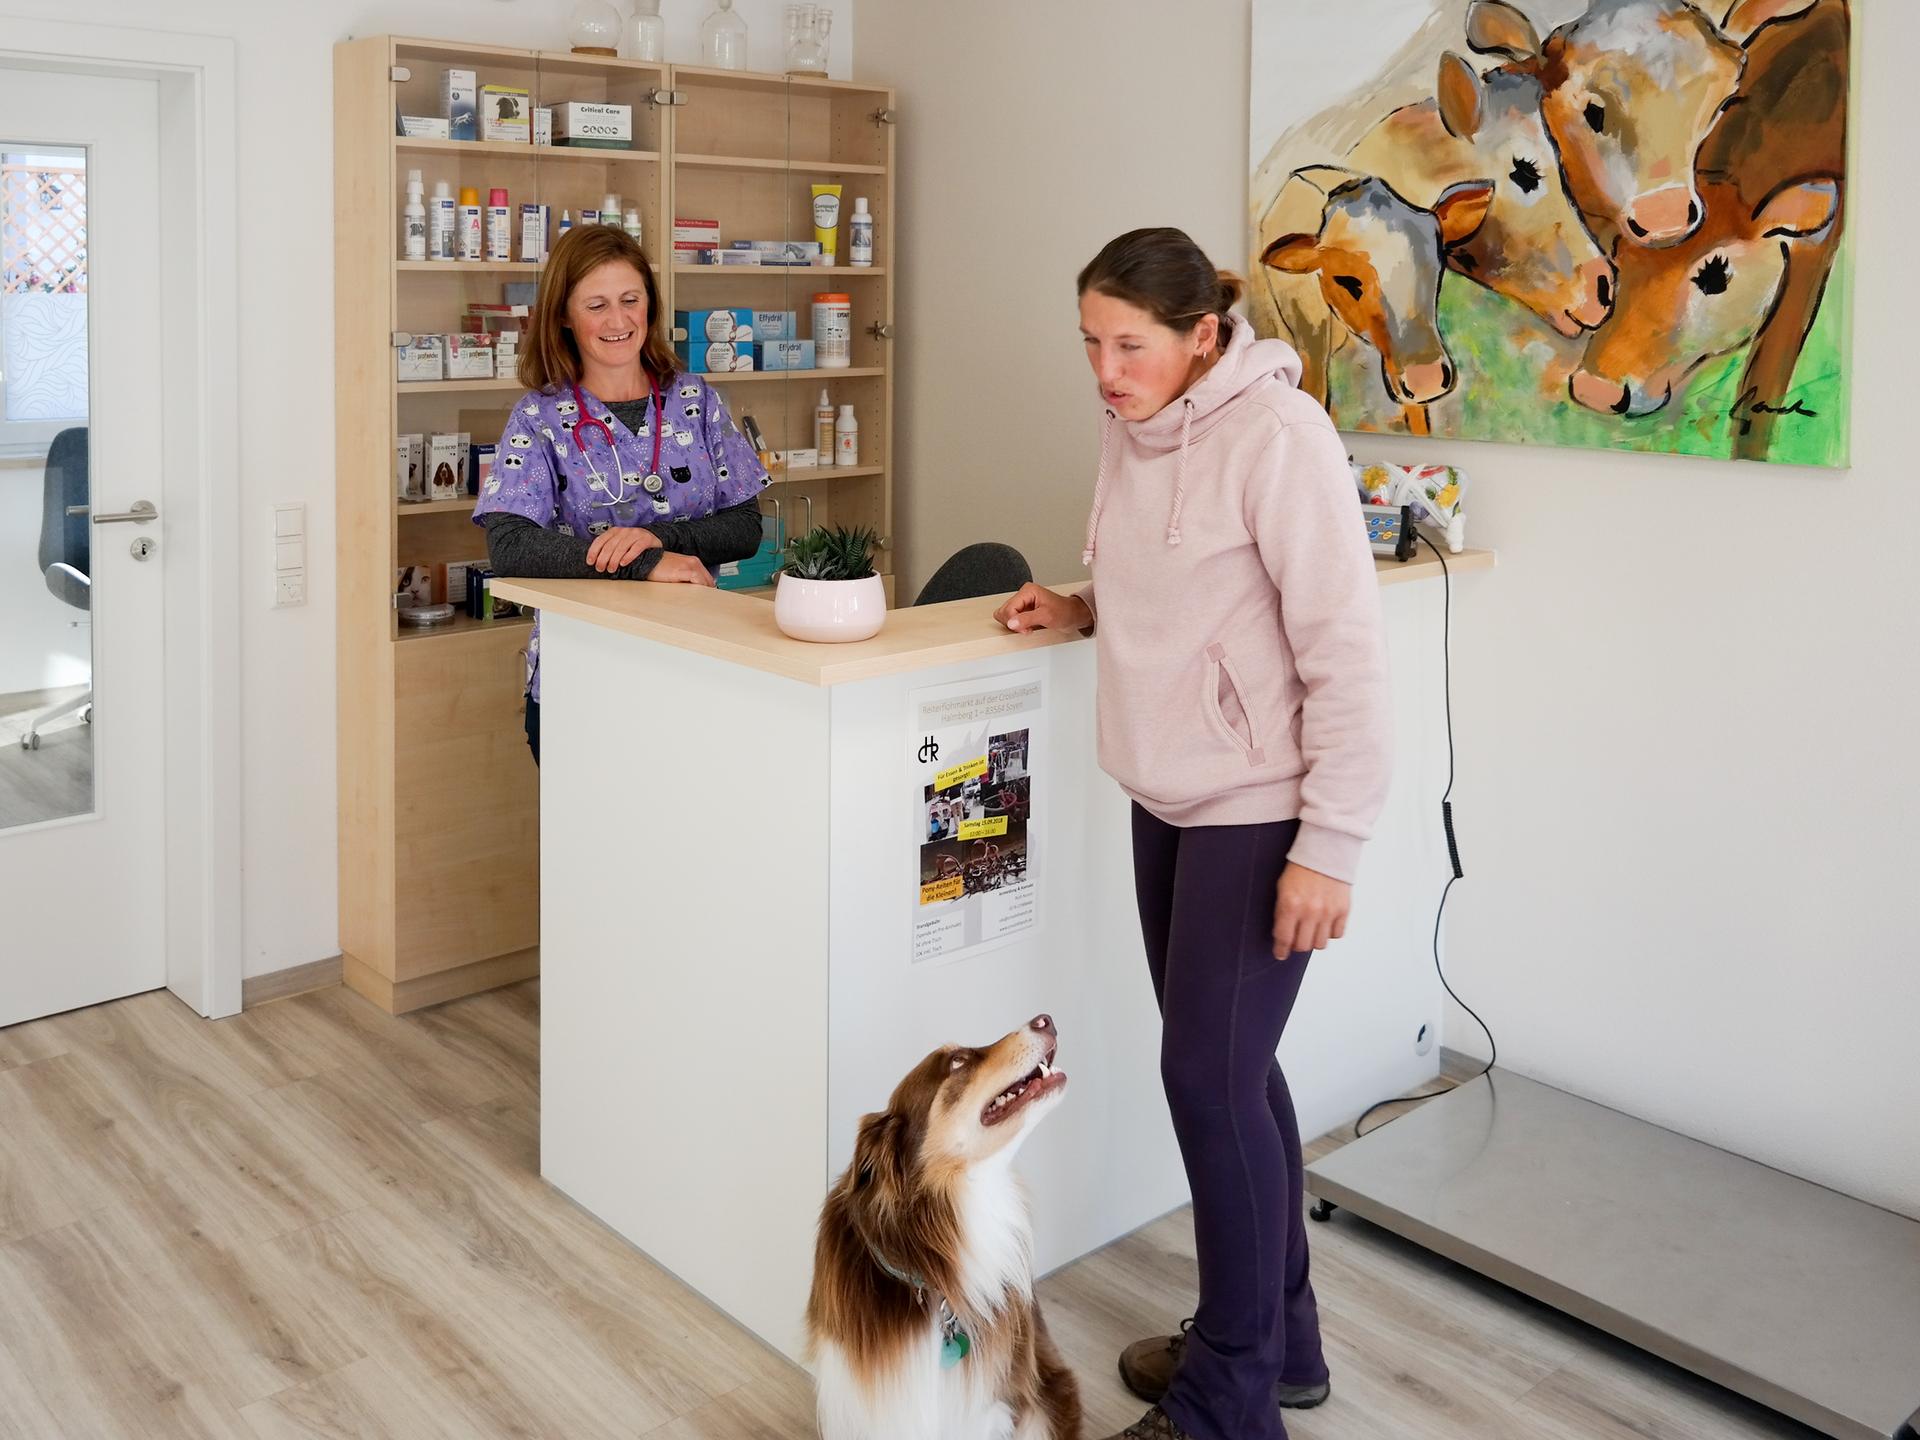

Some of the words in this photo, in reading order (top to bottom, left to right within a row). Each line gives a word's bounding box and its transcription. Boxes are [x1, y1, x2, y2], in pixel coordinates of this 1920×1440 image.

[581, 106, 604, 114] Critical
[759, 313, 783, 323] Effydral
[975, 696, 986, 706] auf
[987, 694, 998, 704] der
[946, 768, 958, 778] Essen
[953, 877, 961, 885] für
[927, 894, 935, 902] die
